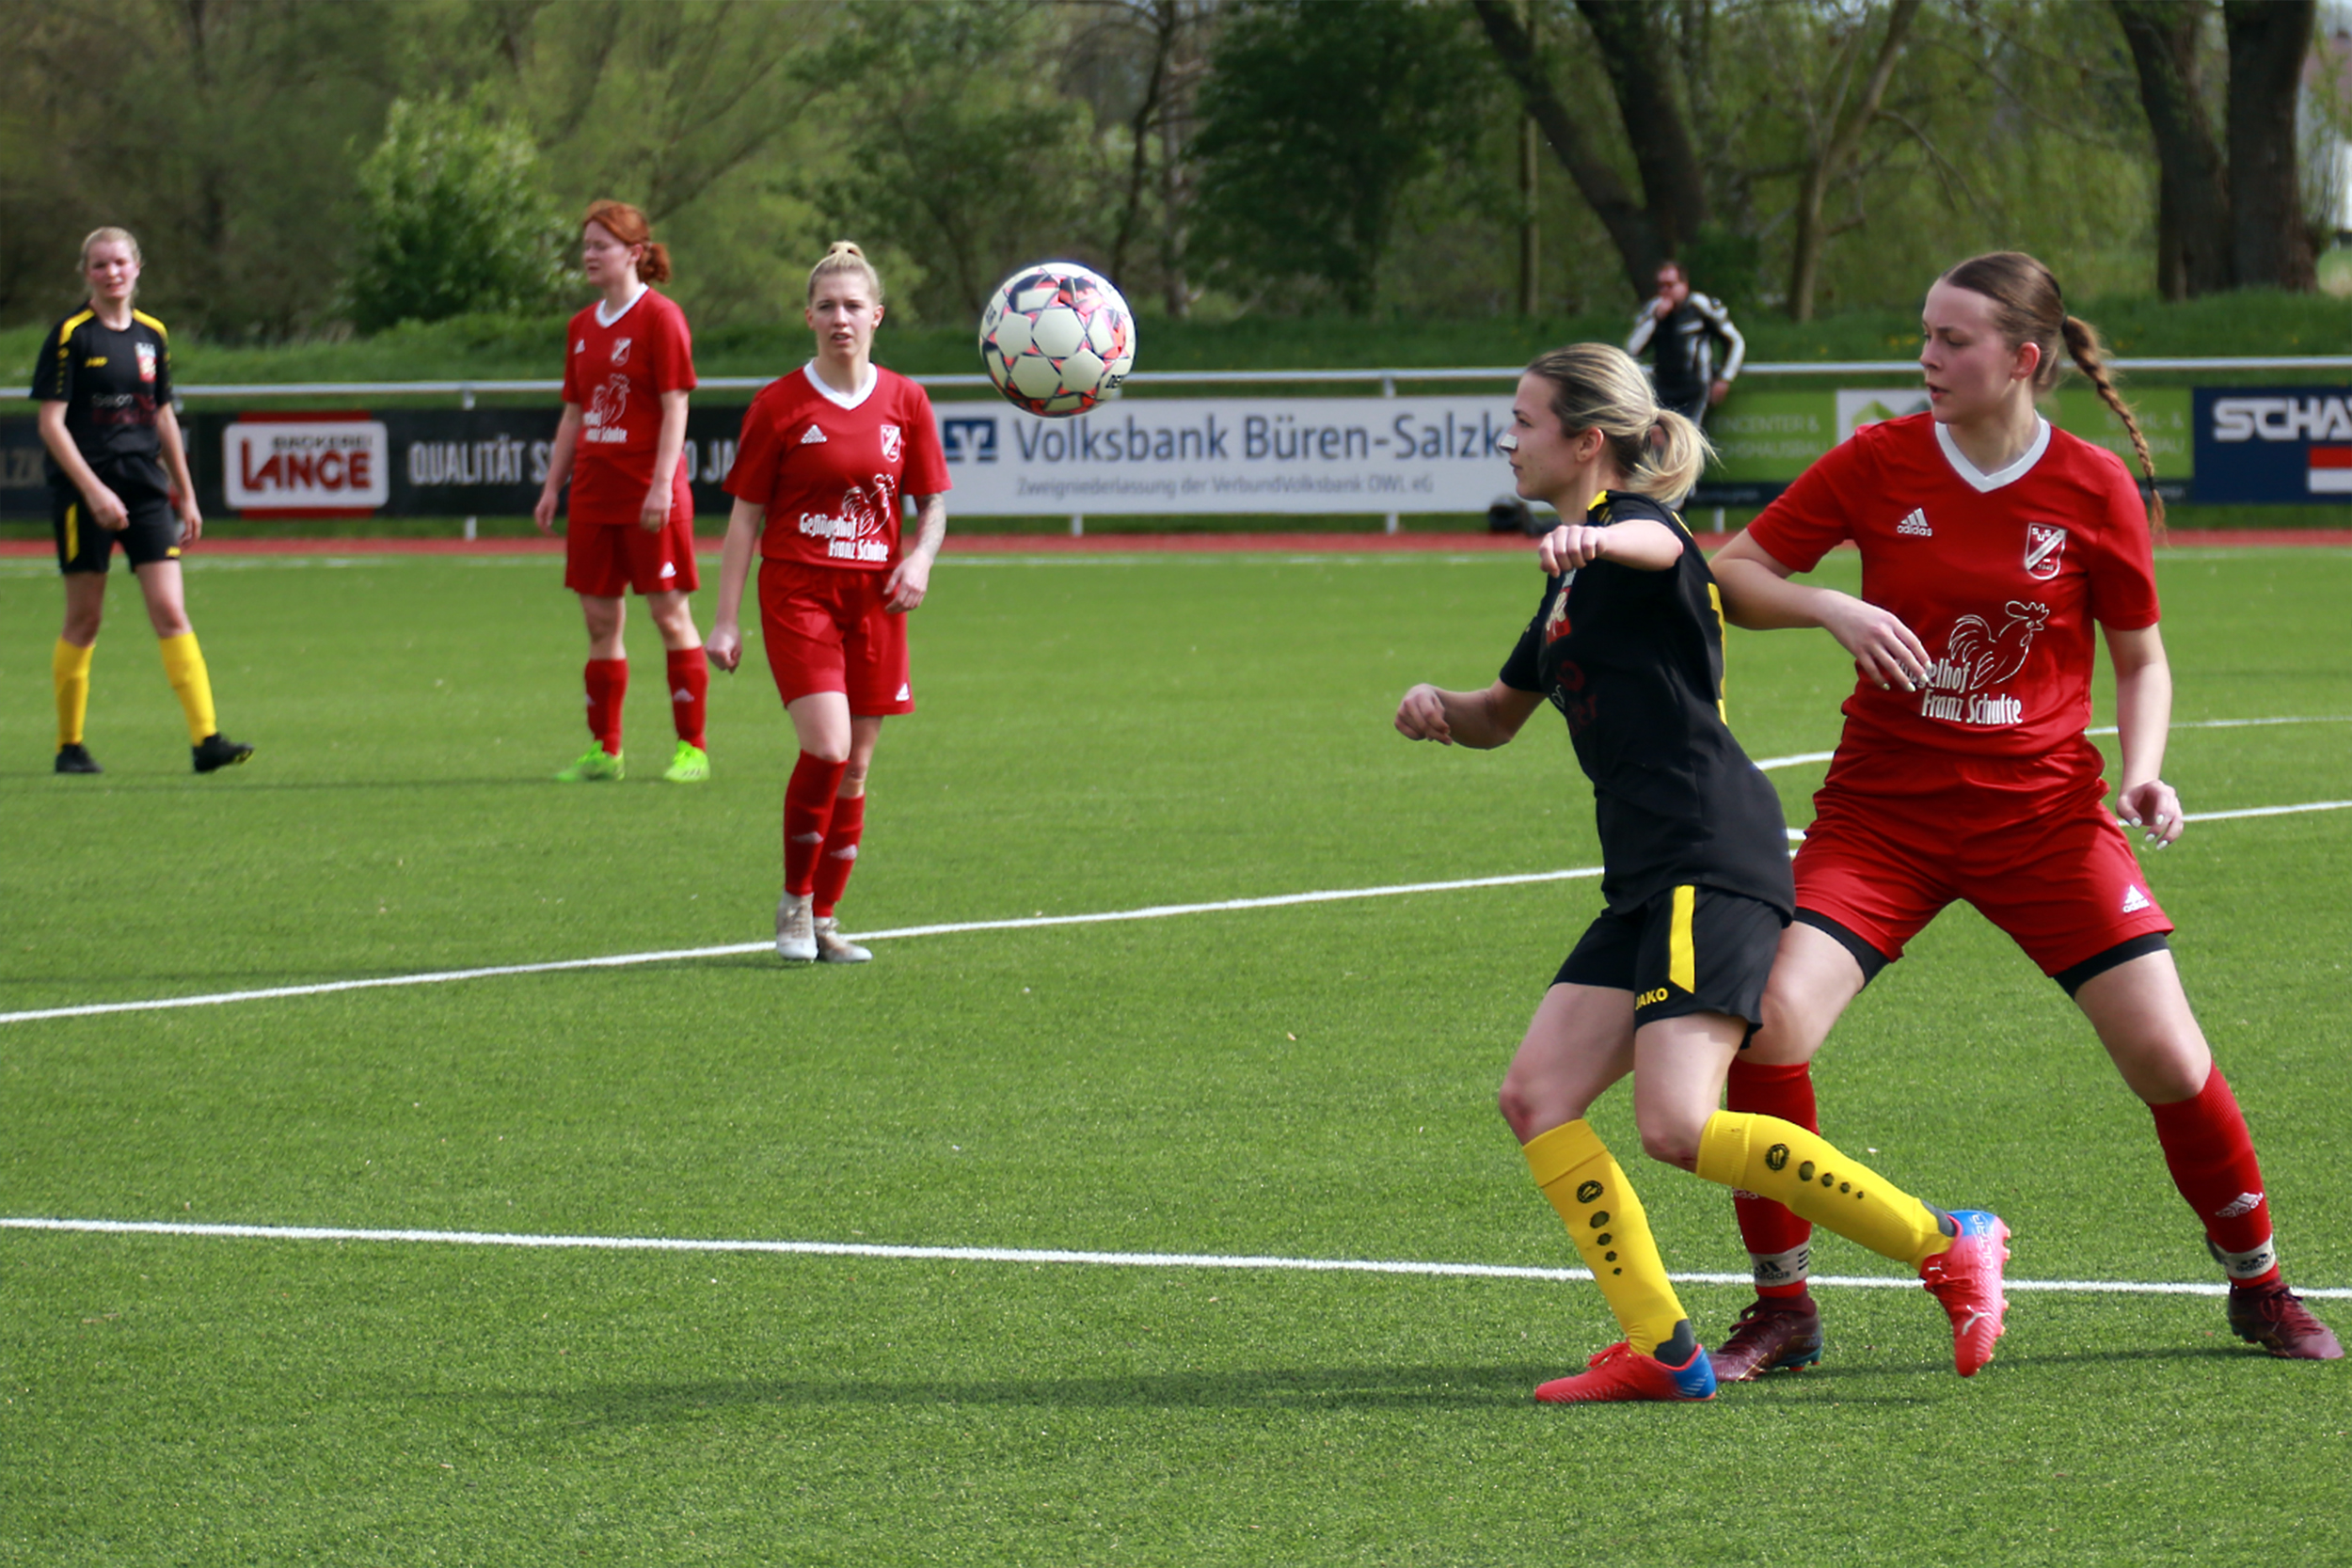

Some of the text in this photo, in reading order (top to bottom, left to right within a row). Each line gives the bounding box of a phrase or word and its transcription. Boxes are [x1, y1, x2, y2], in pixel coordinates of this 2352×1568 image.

[1014, 412, 1229, 463] Volksbank
[407, 434, 526, 485] QUALITÄT
[1182, 476, 1207, 495] der
[799, 513, 857, 541] Geflügelhof
[1897, 525, 1933, 537] adidas
[828, 538, 887, 562] Franz Schulte
[1922, 689, 2024, 725] Franz Schulte
[1635, 987, 1669, 1011] JAKO
